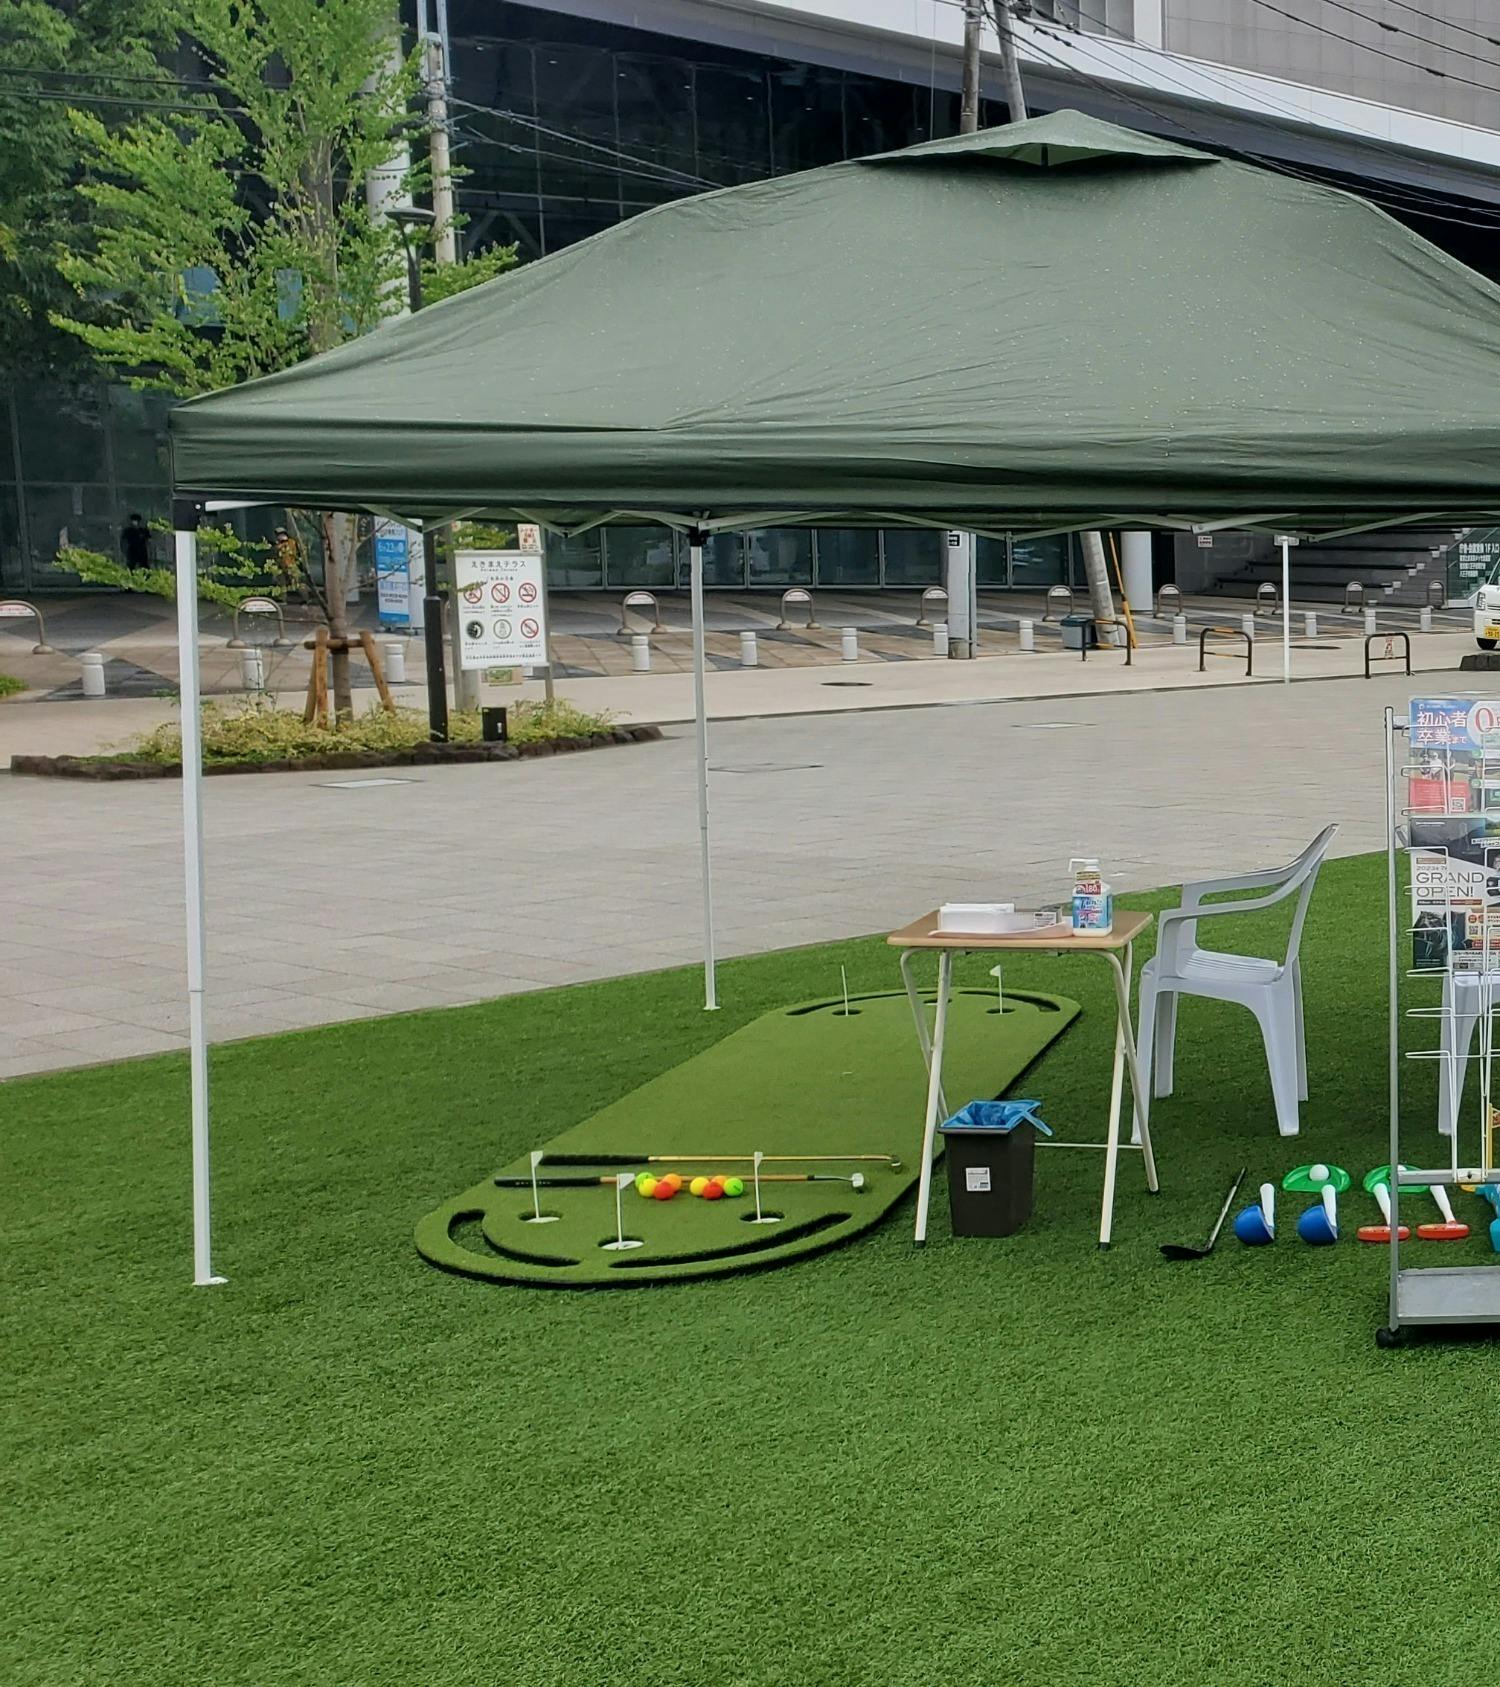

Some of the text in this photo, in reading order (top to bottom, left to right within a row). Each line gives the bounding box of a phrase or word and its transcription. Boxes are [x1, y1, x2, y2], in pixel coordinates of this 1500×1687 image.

[1417, 710, 1467, 727] 初心者
[1417, 729, 1467, 745] 卒業まで
[1416, 872, 1485, 883] GRAND
[1416, 886, 1474, 897] OPEN!
